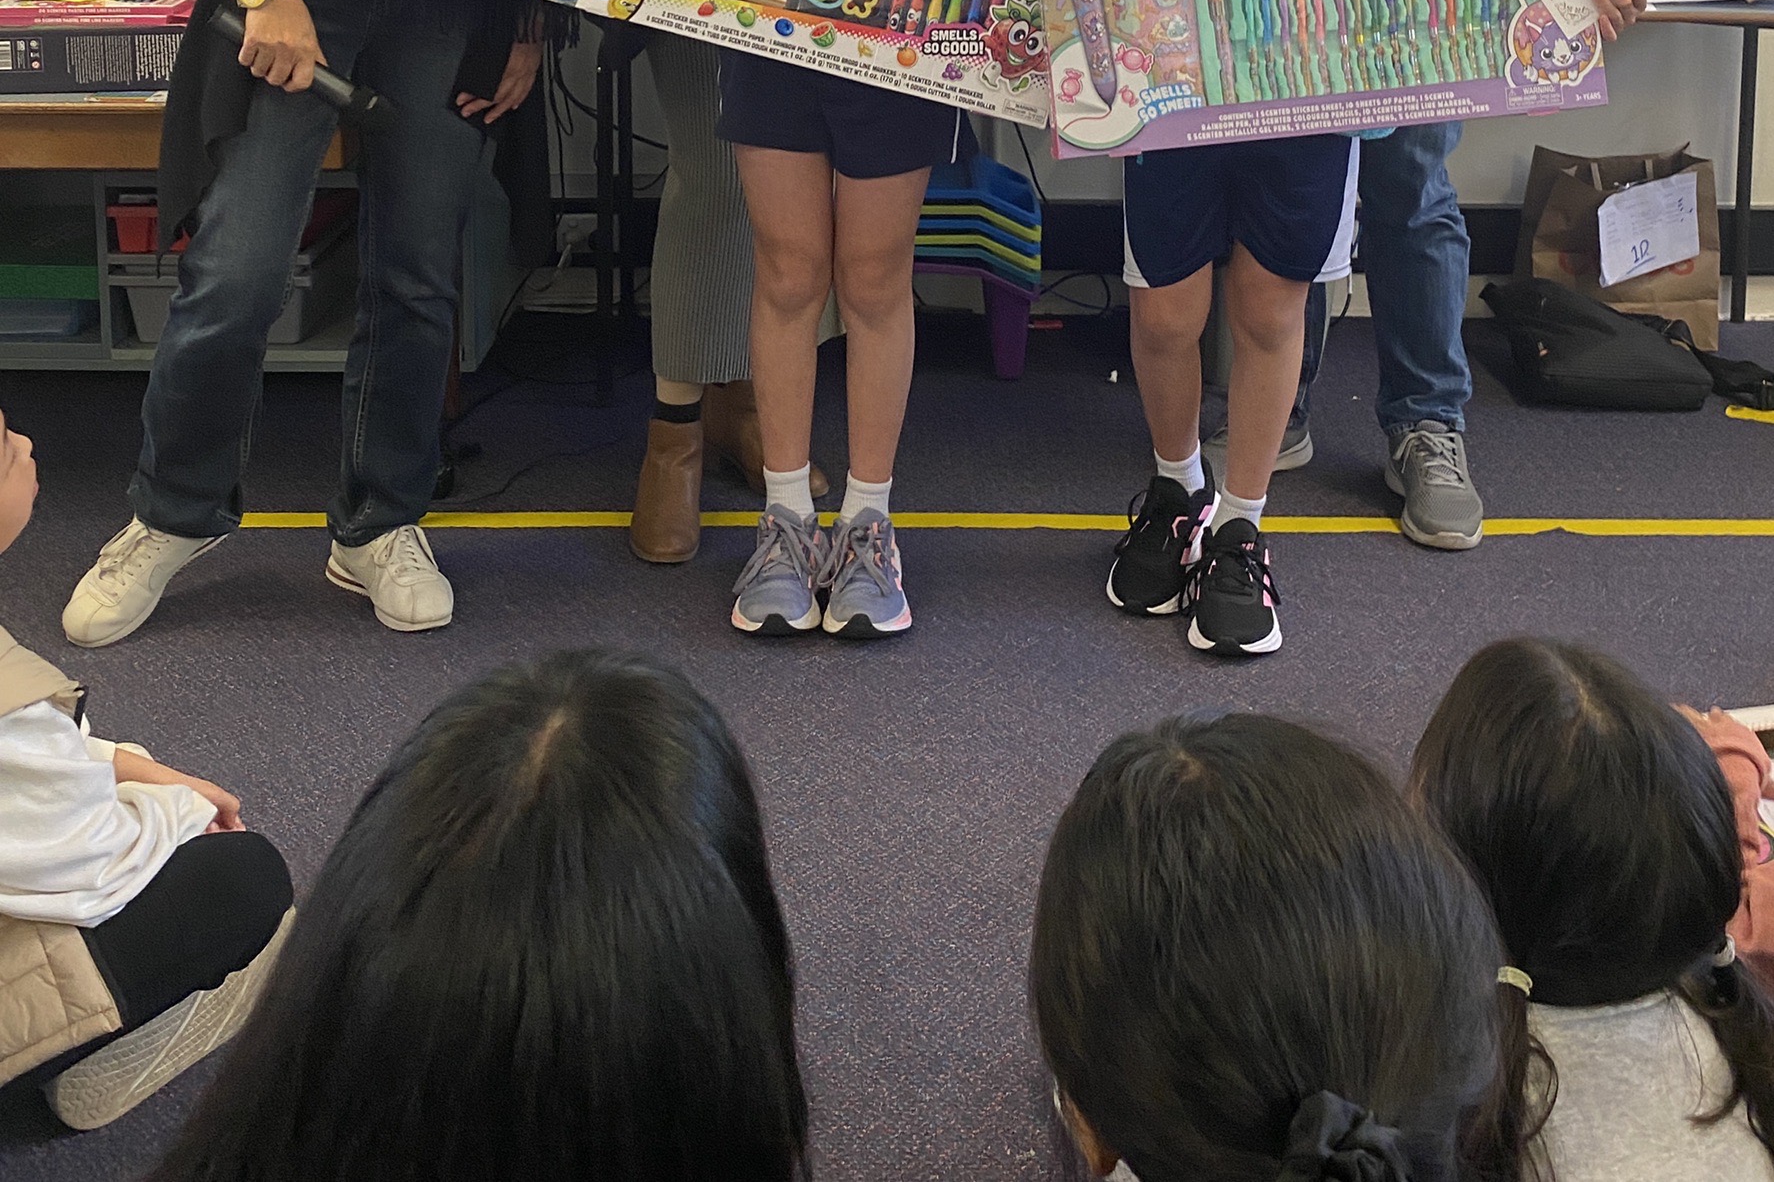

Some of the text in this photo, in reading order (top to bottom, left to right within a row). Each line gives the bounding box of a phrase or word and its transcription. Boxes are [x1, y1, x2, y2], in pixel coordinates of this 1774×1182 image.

[931, 29, 977, 41] SMELLS
[666, 12, 944, 89] STICKER SHEETS PEN LINE SCENTED FINE
[923, 41, 985, 55] SO GOOD!
[650, 16, 995, 110] SCENTED SCENTED NET NET CUTTERS ROLLER
[1140, 84, 1192, 104] SMELLS
[1260, 91, 1454, 117] SCENTED SHEETS SCENTED
[1583, 92, 1601, 100] YEARS
[1139, 97, 1203, 123] SO SWEET!
[1261, 115, 1291, 125] SCENTED
[1372, 104, 1402, 114] SCENTED
[1193, 130, 1223, 140] SCENTED
[1258, 125, 1271, 134] GEL
[1405, 109, 1434, 119] SCENTED
[1472, 104, 1489, 113] PENS
